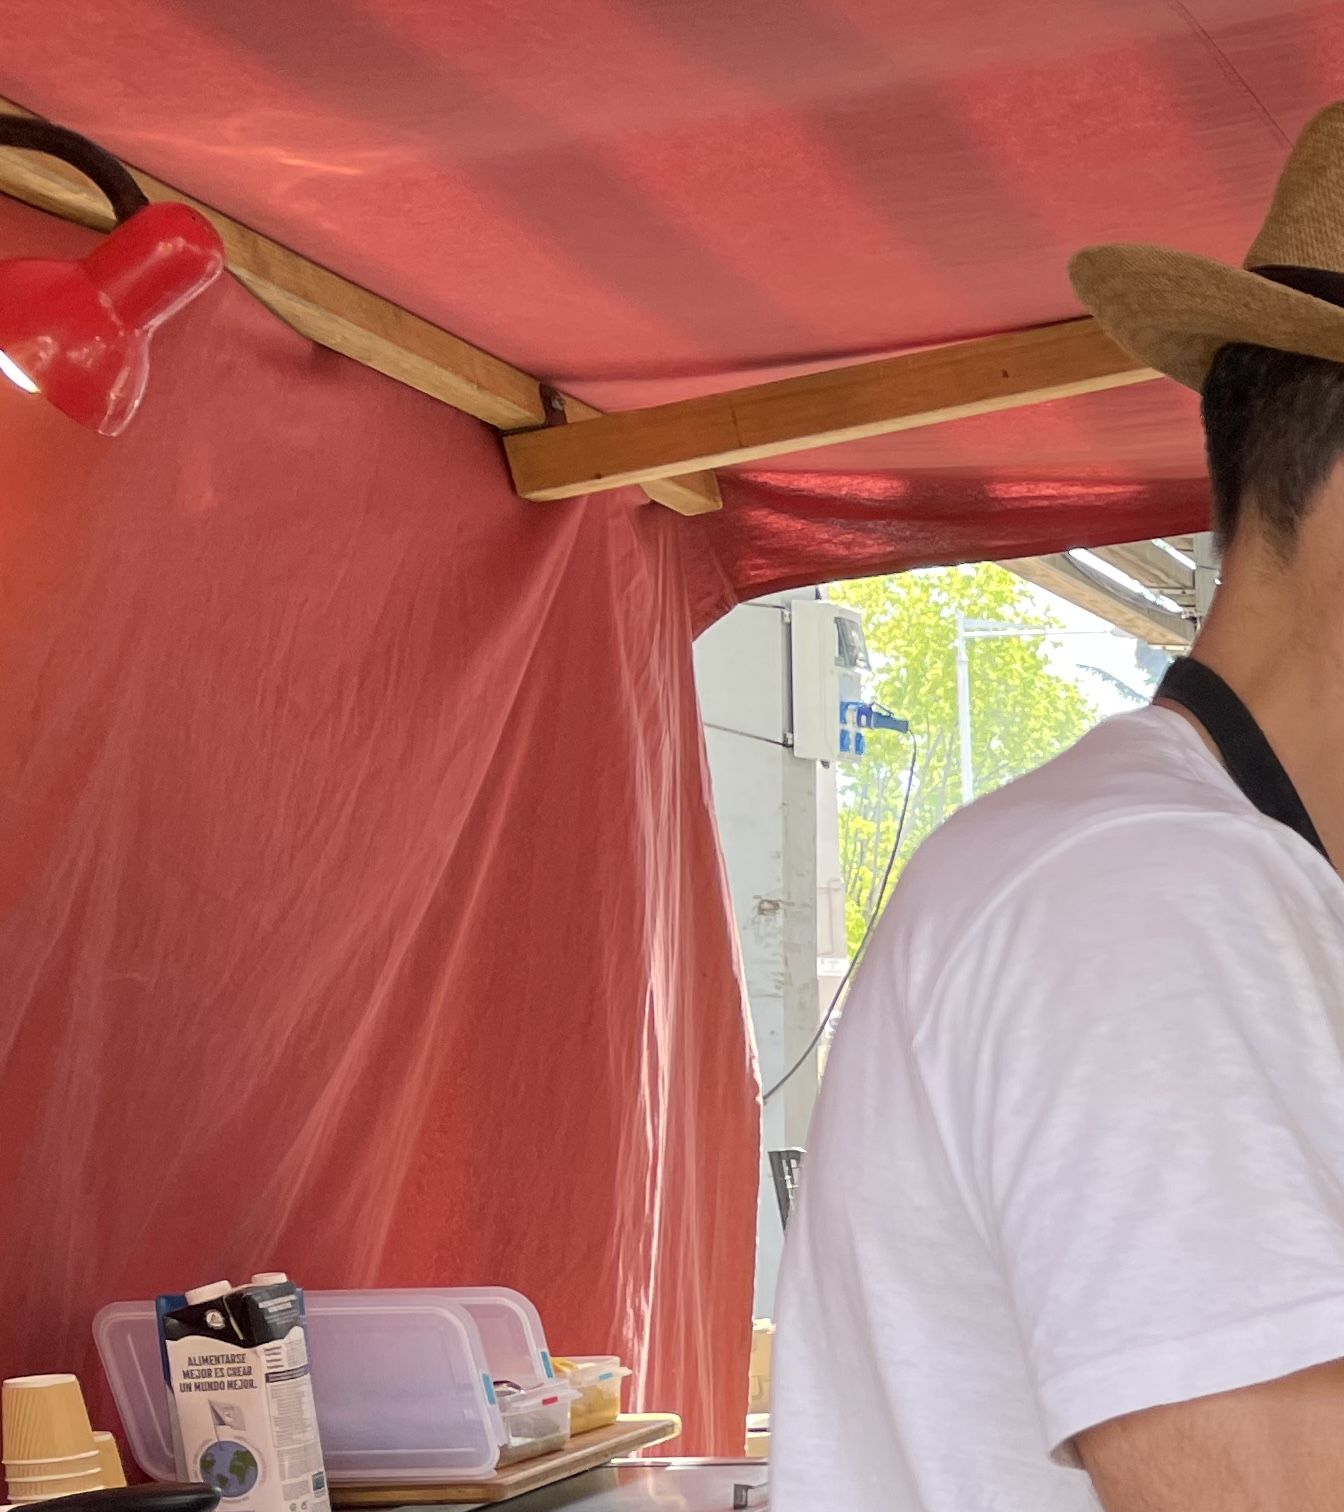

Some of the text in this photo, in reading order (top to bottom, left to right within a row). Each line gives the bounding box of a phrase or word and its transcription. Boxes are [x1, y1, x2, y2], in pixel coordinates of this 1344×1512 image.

[187, 1353, 247, 1367] ALIMENTARSE
[182, 1368, 213, 1380] MEJOR
[214, 1367, 225, 1378] ES
[226, 1366, 252, 1378] CREAR
[179, 1382, 192, 1393] UN
[194, 1380, 226, 1392] MUNDO
